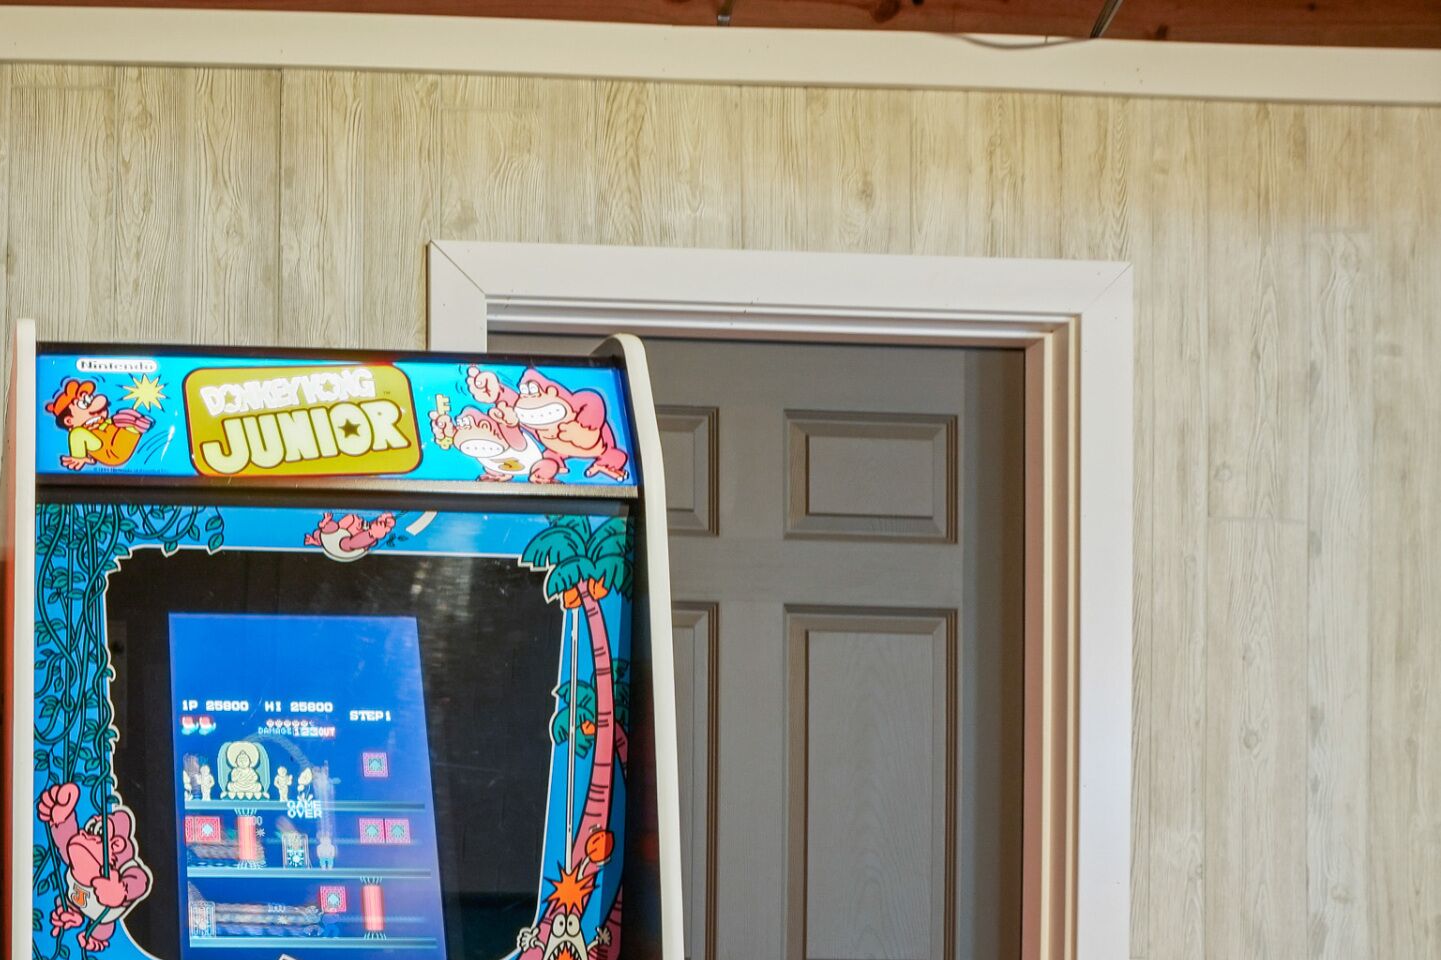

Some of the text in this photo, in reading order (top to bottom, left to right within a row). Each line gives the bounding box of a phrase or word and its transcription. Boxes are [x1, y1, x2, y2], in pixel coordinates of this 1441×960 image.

[199, 368, 376, 417] DONKEY KONG
[200, 400, 412, 474] JUNIOR
